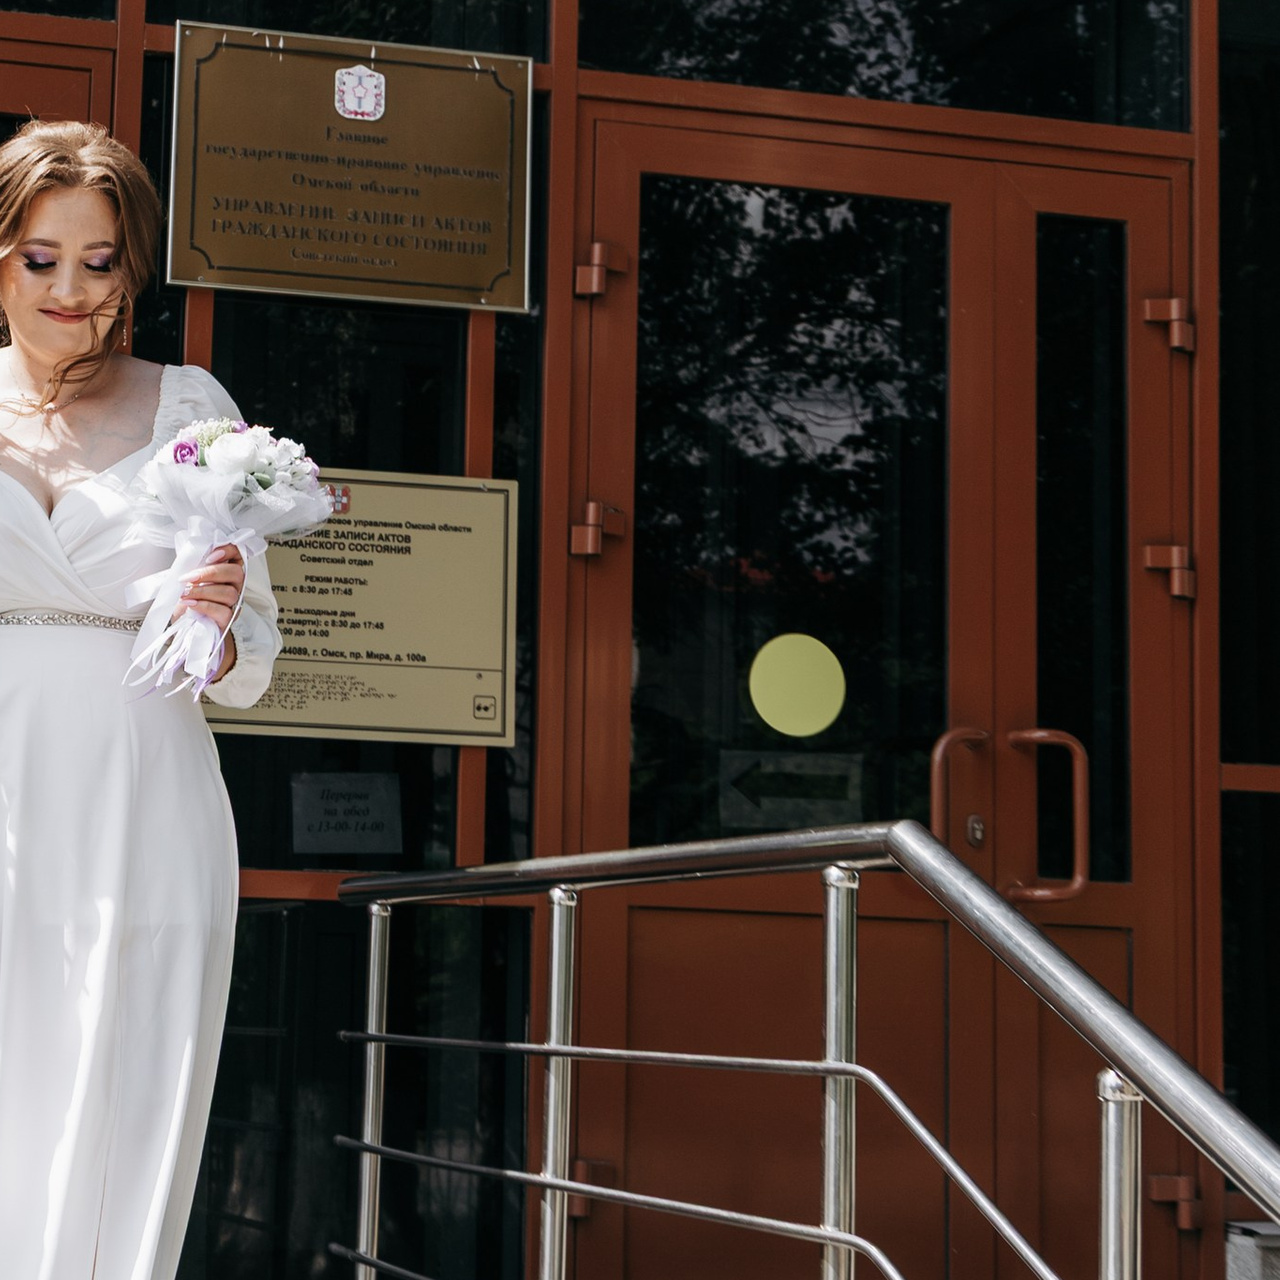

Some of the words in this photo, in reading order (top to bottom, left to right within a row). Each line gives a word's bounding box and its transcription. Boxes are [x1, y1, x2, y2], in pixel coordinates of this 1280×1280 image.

[325, 126, 389, 146] Главное
[206, 144, 408, 171] государственно-правовое
[414, 162, 502, 182] управление
[291, 172, 353, 191] Омской
[359, 179, 421, 197] области
[212, 196, 338, 220] УПРАВЛЕНИЕ
[346, 206, 426, 228] ЗАПИСИ
[429, 216, 493, 235] АКТОВ
[211, 218, 368, 246] ГРАЖДАНСКОГО
[373, 233, 488, 256] СОСТОЯНИЯ
[354, 519, 403, 529] управление
[405, 521, 437, 531] Омской
[438, 523, 472, 533] области
[333, 530, 375, 541] ЗАПИСИ
[377, 533, 412, 544] АКТОВ
[267, 538, 346, 551] РАЖДАНСКОГО
[348, 542, 412, 555] СОСТОЯНИЯ
[300, 554, 345, 566] Советский
[348, 558, 374, 567] отдел
[304, 575, 333, 584] РЕЖИМ
[334, 577, 369, 586] РАБОТЫ:
[271, 584, 288, 592] ота:
[299, 585, 317, 594] 8:30
[318, 587, 330, 596] до
[331, 587, 353, 596] 17:45
[294, 607, 338, 617] выходные
[339, 610, 356, 618] дни
[330, 619, 348, 629] 8:30
[350, 621, 361, 630] до
[363, 621, 385, 630] 17:45
[277, 626, 293, 636] :00
[295, 629, 306, 637] до
[308, 628, 330, 638] 14:00
[279, 646, 311, 657] 44089,
[321, 648, 347, 659] Омск,
[349, 651, 364, 660] пр.
[366, 650, 393, 662] Мира,
[394, 653, 404, 662] д.
[406, 653, 427, 663] 100а
[320, 789, 370, 802] Перерыв
[323, 807, 338, 817] на
[343, 805, 370, 818] обед
[307, 824, 315, 833] с
